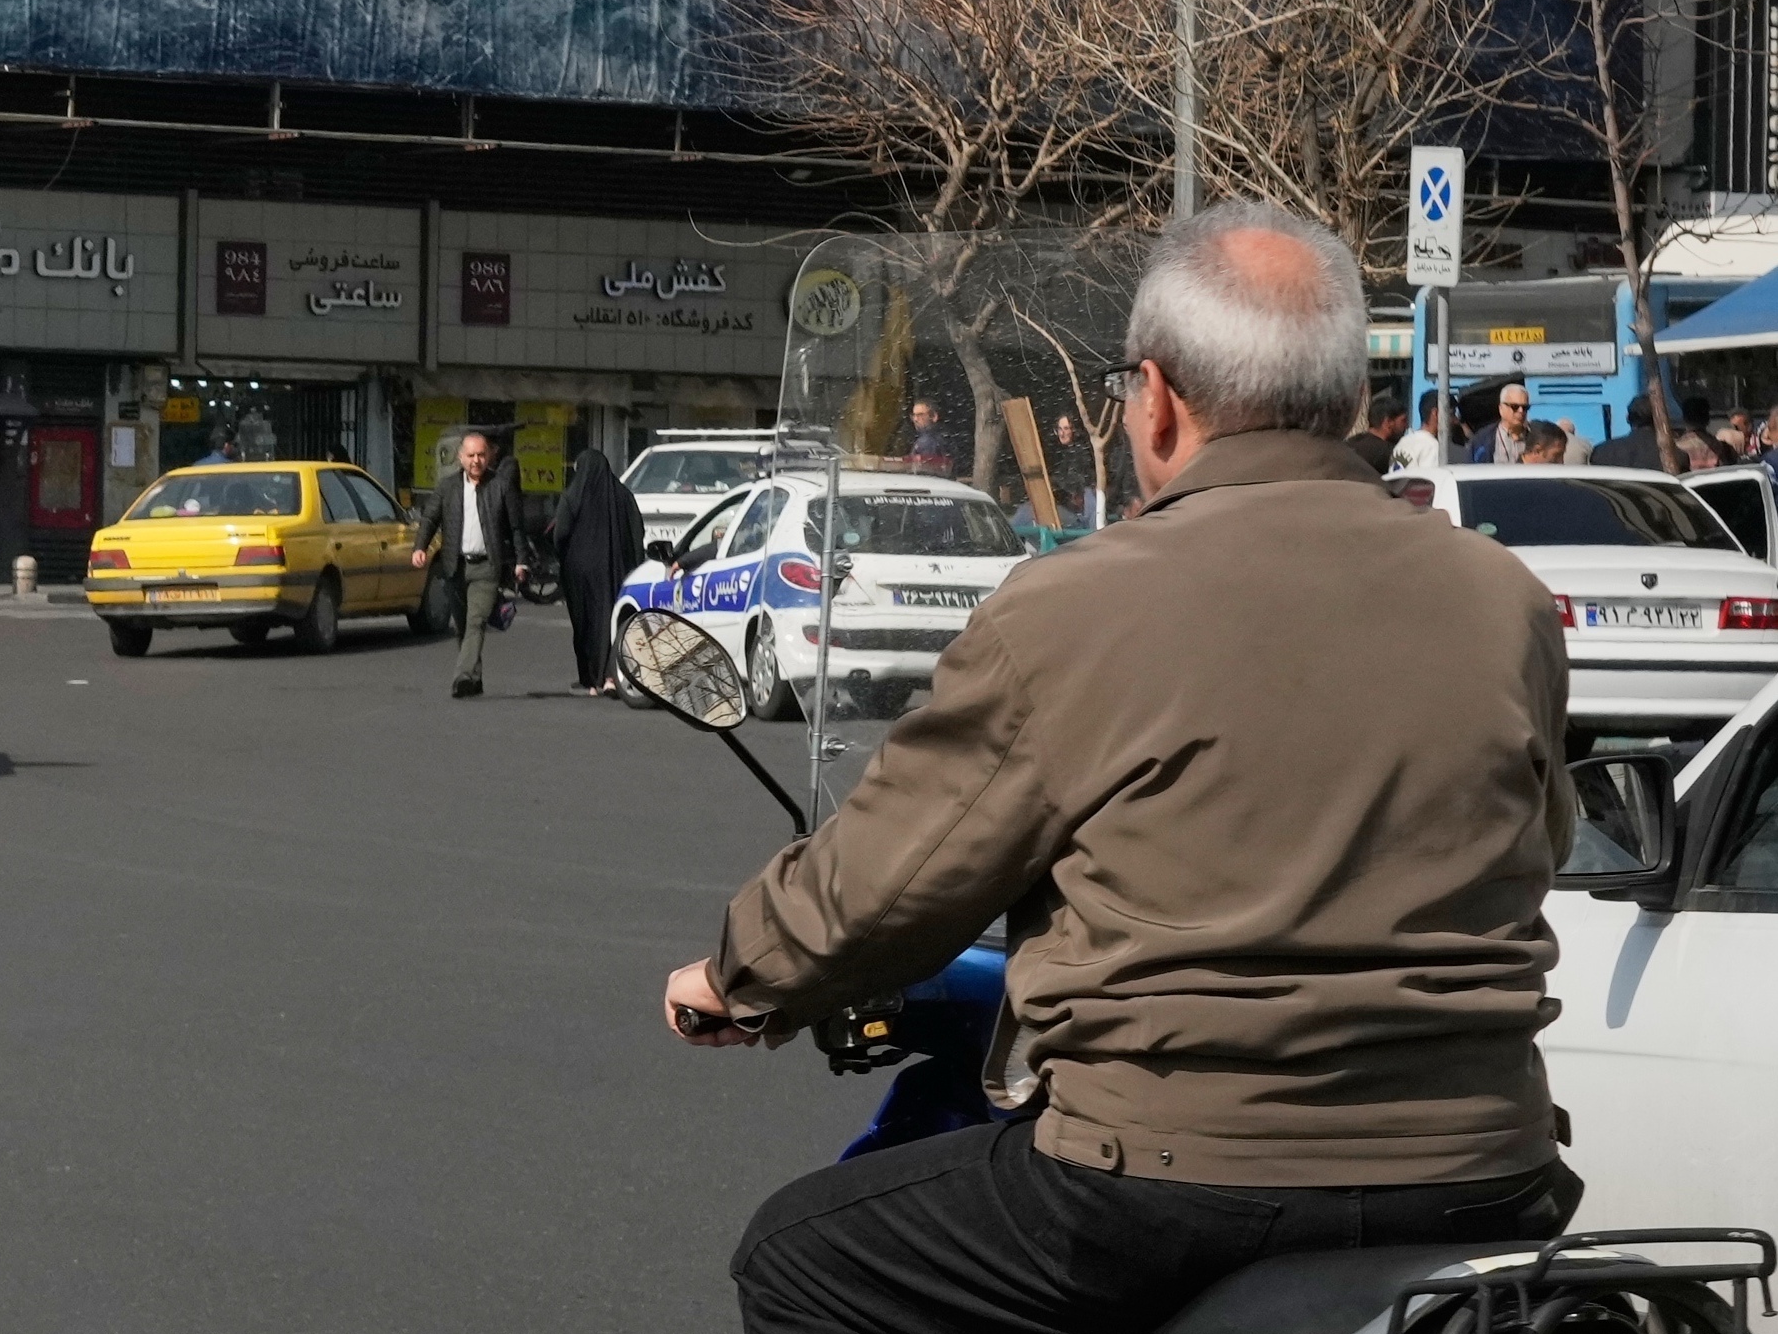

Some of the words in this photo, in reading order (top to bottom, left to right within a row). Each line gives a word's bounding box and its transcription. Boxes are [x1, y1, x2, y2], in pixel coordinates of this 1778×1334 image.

[36, 235, 134, 297] بانک
[224, 249, 262, 266] 984
[469, 260, 507, 276] 986
[603, 260, 654, 298] ملی
[655, 258, 728, 300] کفش
[309, 279, 403, 316] ساعتی
[572, 306, 623, 330] انقلاب
[708, 572, 739, 607] پلیس
